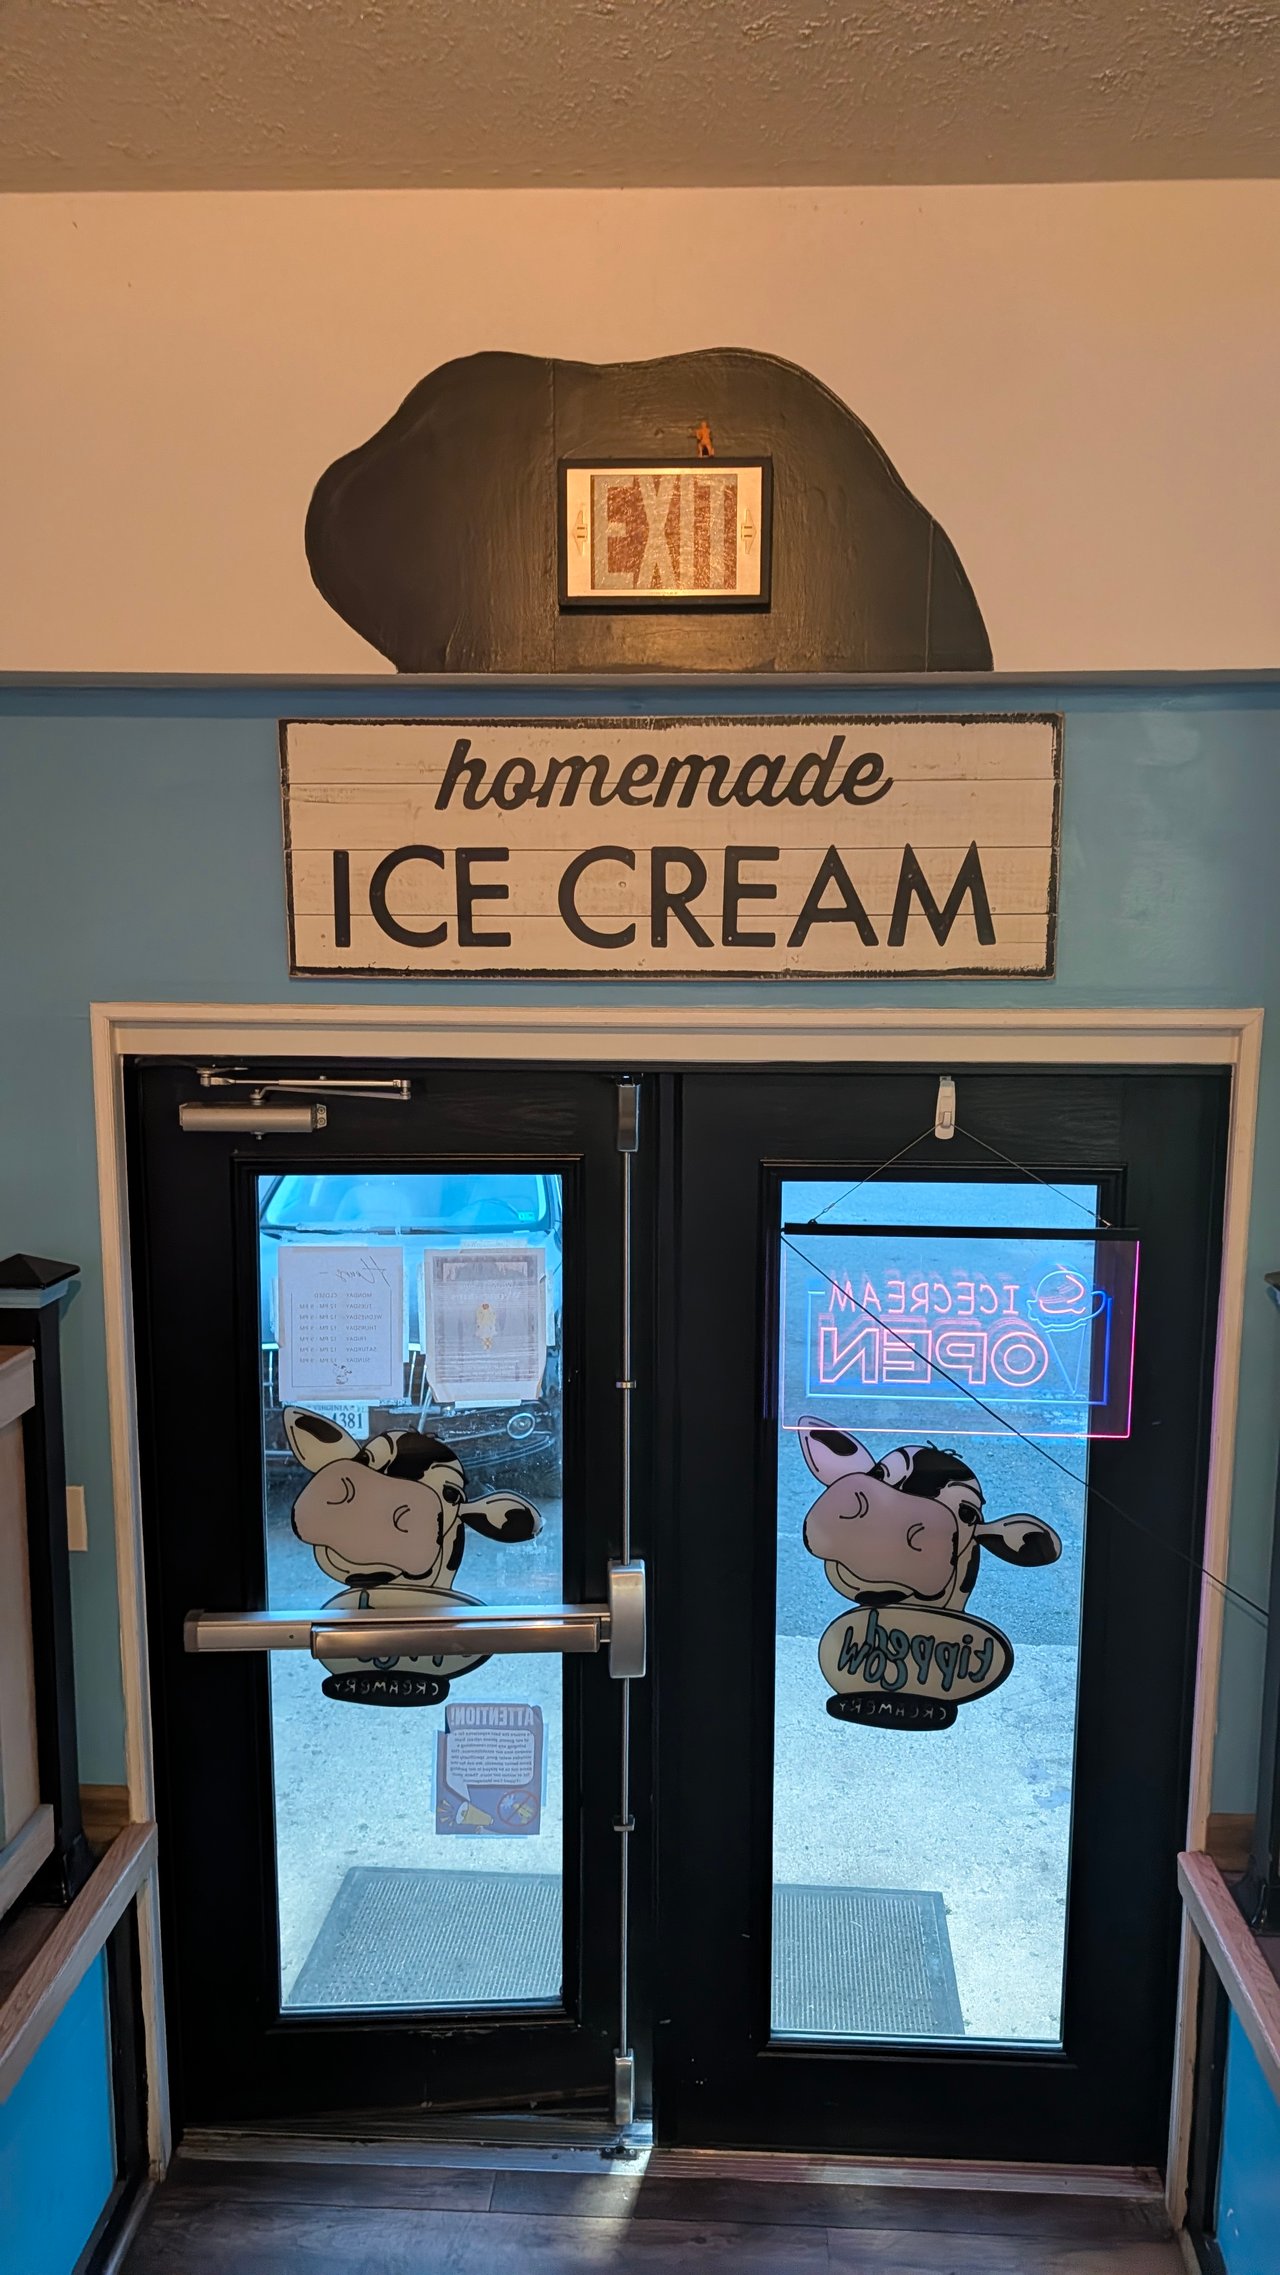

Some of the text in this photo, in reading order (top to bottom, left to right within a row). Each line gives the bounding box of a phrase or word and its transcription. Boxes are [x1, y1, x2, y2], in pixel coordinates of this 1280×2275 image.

[593, 474, 737, 590] EXIT
[434, 735, 893, 811] homemade
[332, 841, 997, 949] ICE CREAM
